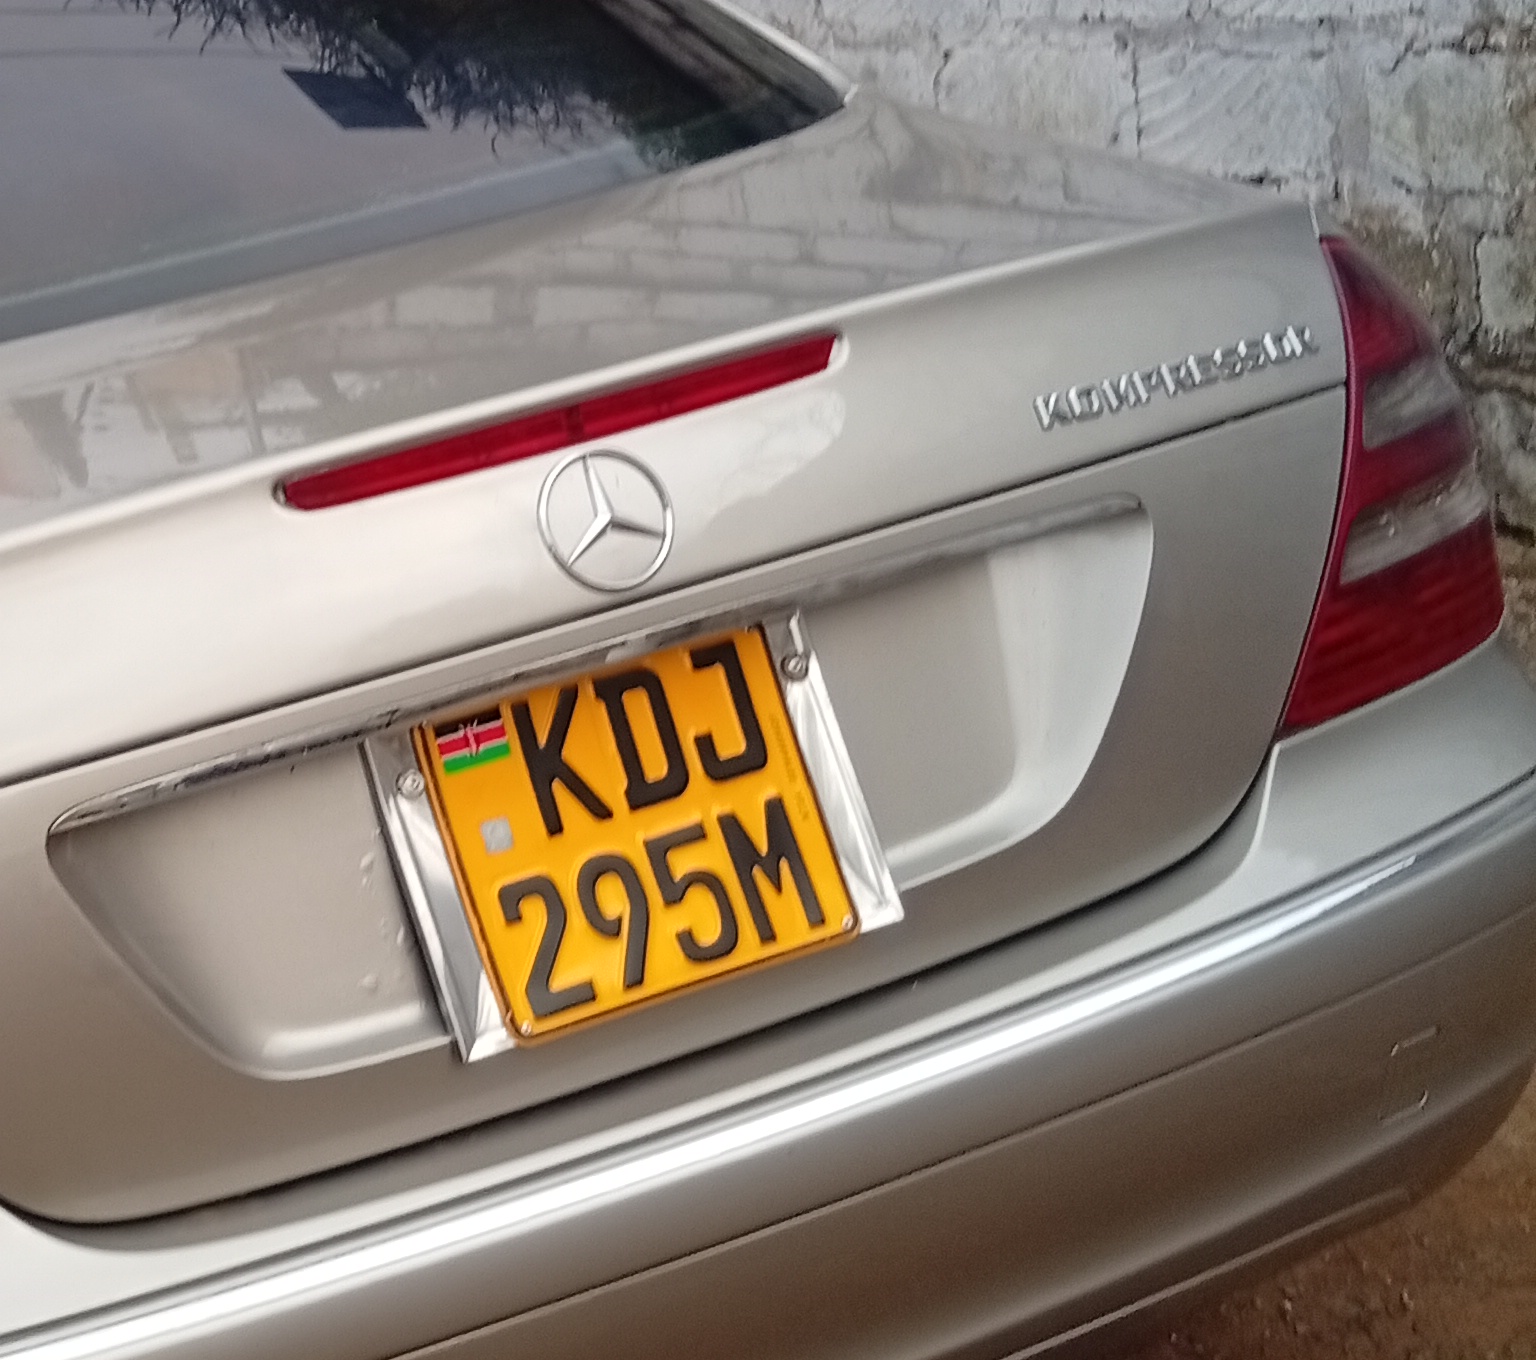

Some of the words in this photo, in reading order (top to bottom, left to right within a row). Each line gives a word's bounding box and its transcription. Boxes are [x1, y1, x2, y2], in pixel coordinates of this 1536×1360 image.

[1033, 325, 1318, 431] KOMPRESSOR
[511, 640, 768, 838] KDJ
[497, 796, 825, 1019] 295M
